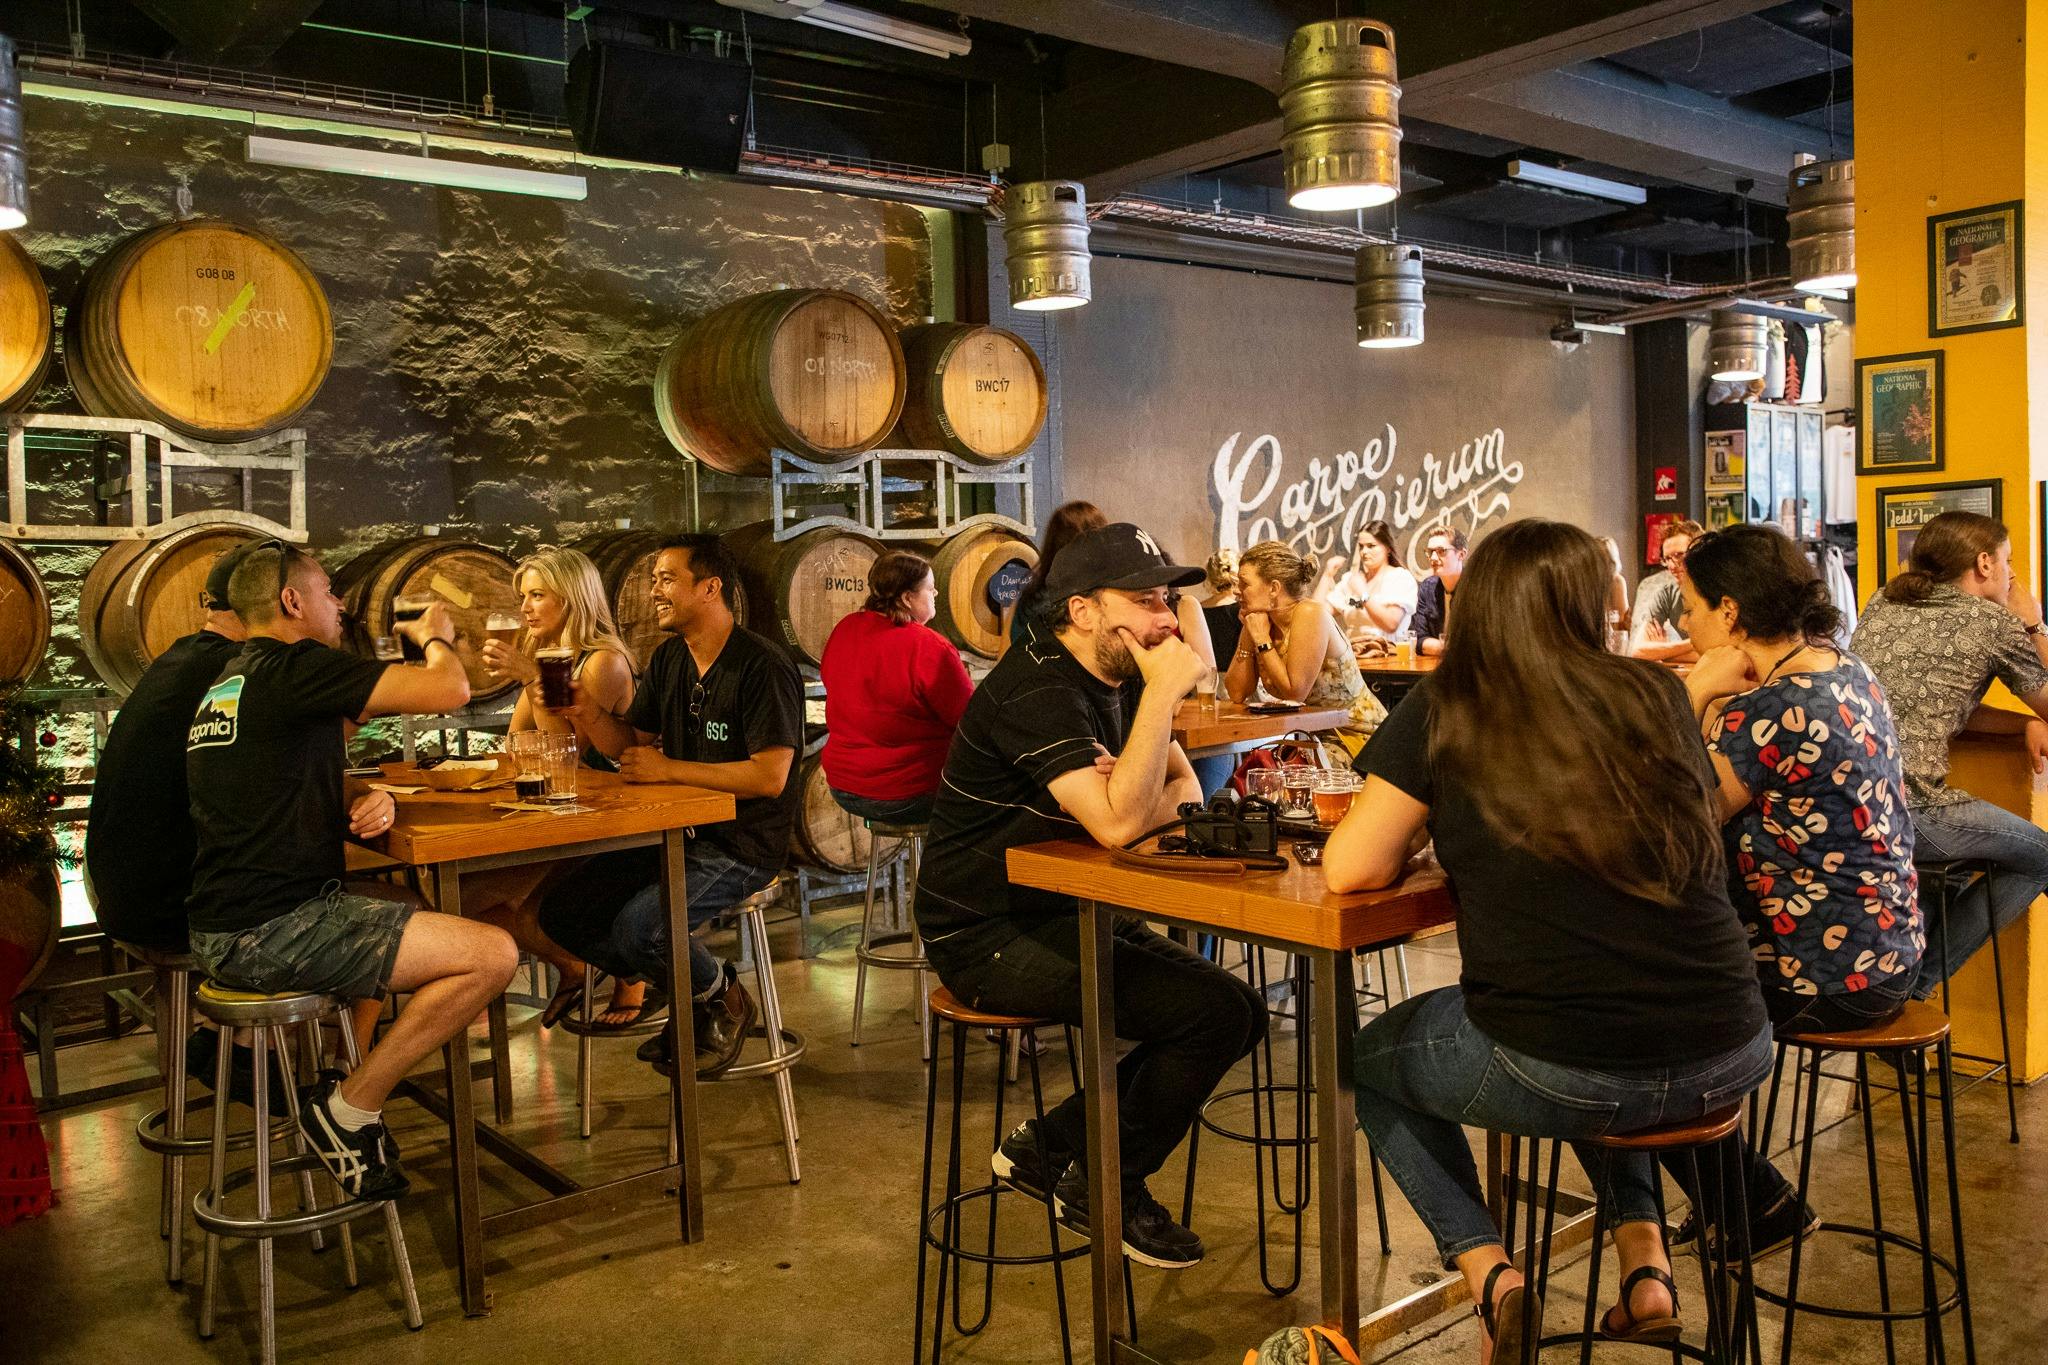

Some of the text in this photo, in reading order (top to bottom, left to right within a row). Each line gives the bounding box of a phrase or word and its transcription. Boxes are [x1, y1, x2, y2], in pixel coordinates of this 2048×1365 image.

[1957, 223, 1994, 236] NATIONAL
[1949, 229, 2000, 247] GEOGRAPHIC
[975, 378, 1010, 393] BWC17
[1883, 374, 1918, 384] NATIONAL
[825, 577, 864, 592] BWC13
[188, 717, 231, 744] agonia
[706, 720, 728, 741] GSC
